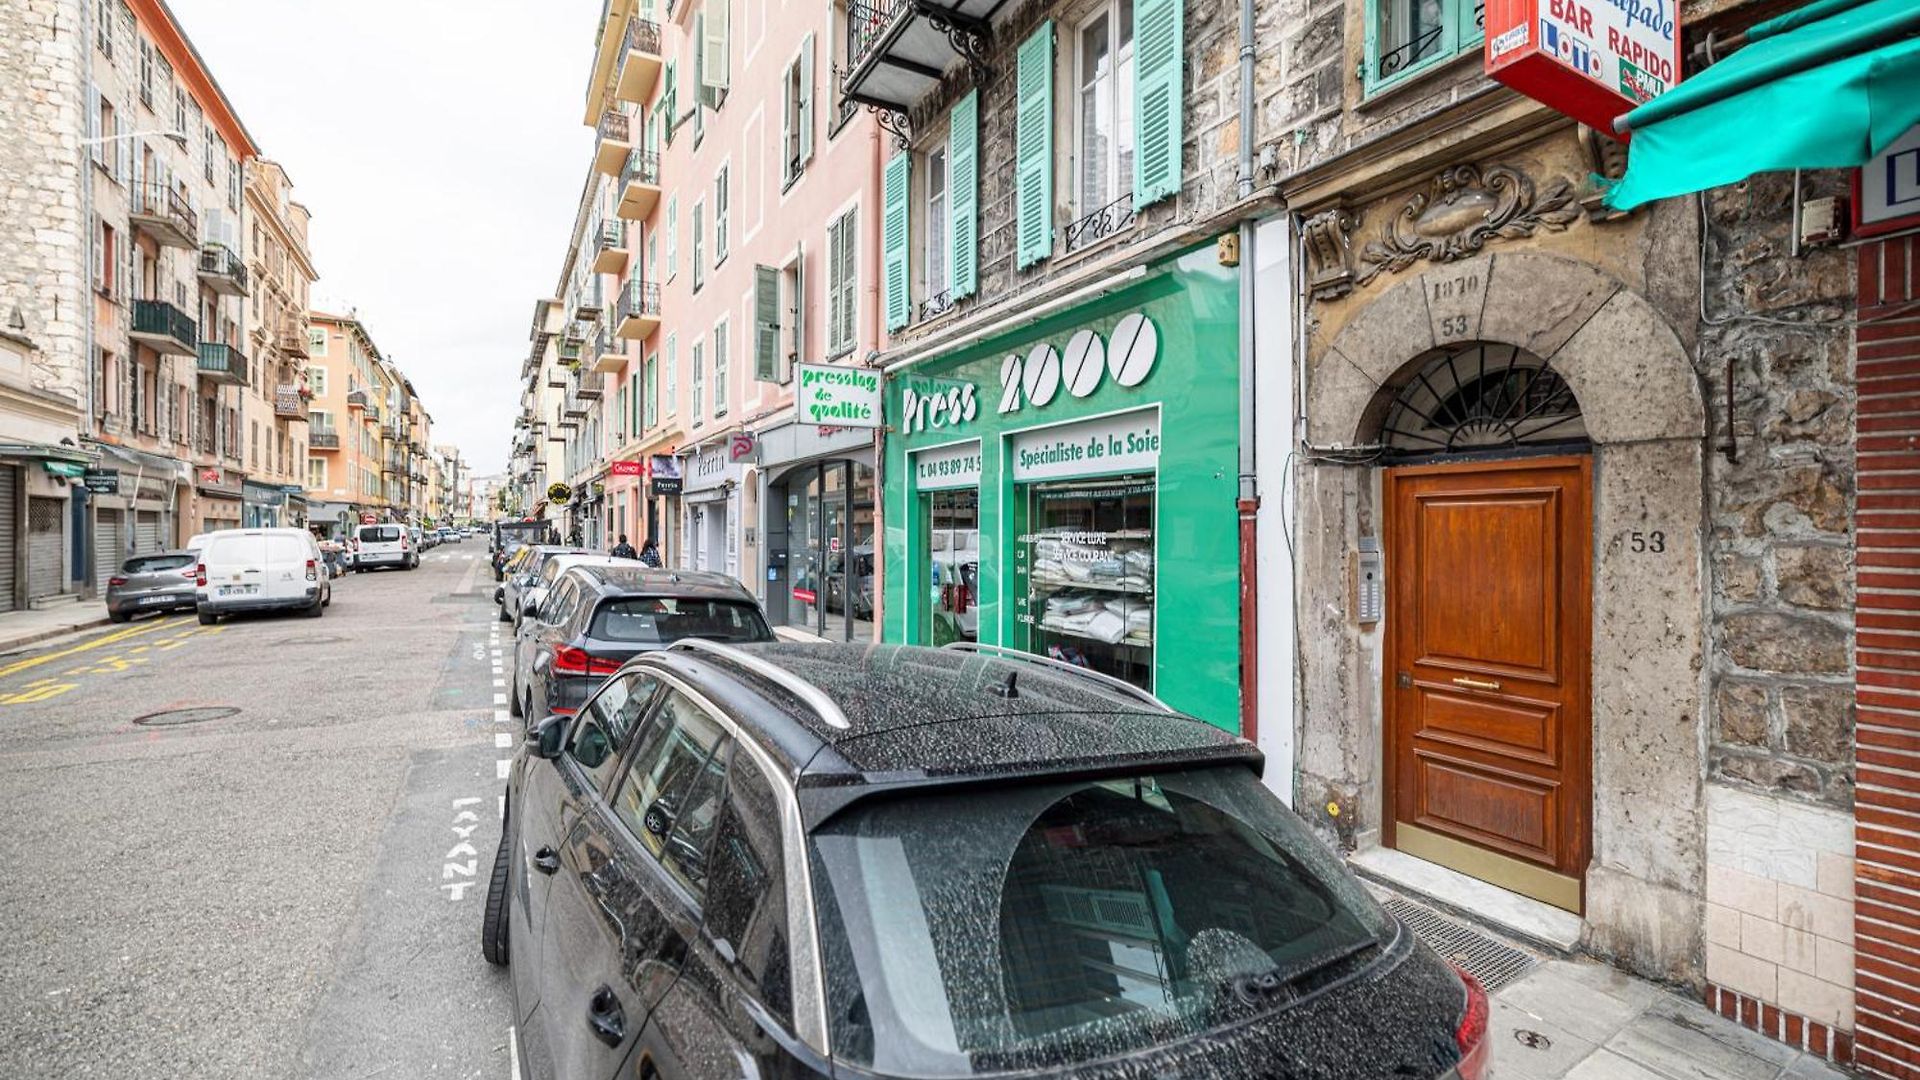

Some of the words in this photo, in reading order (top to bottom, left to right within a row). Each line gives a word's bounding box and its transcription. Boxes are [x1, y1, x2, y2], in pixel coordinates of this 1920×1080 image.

[1550, 0, 1594, 39] BAR
[1541, 19, 1603, 79] LOTO
[1608, 25, 1672, 83] RAPIDO
[1636, 69, 1662, 96] PMU
[1434, 275, 1478, 301] 1870
[1443, 315, 1467, 336] 53
[997, 313, 1157, 413] 2000
[803, 369, 877, 392] pressing
[815, 387, 832, 400] de
[810, 401, 871, 421] qualité
[903, 383, 976, 434] Press
[1020, 443, 1083, 469] Spécialiste
[1087, 437, 1104, 459] de
[1109, 433, 1122, 454] la
[1127, 430, 1159, 453] Soie
[699, 449, 724, 477] Perrin
[927, 462, 937, 477] 04
[939, 460, 949, 475] 93
[950, 459, 962, 474] 89
[963, 457, 974, 472] 74
[1060, 531, 1086, 544] SERVICE
[1087, 532, 1107, 545] LUXE
[1631, 530, 1665, 553] 53
